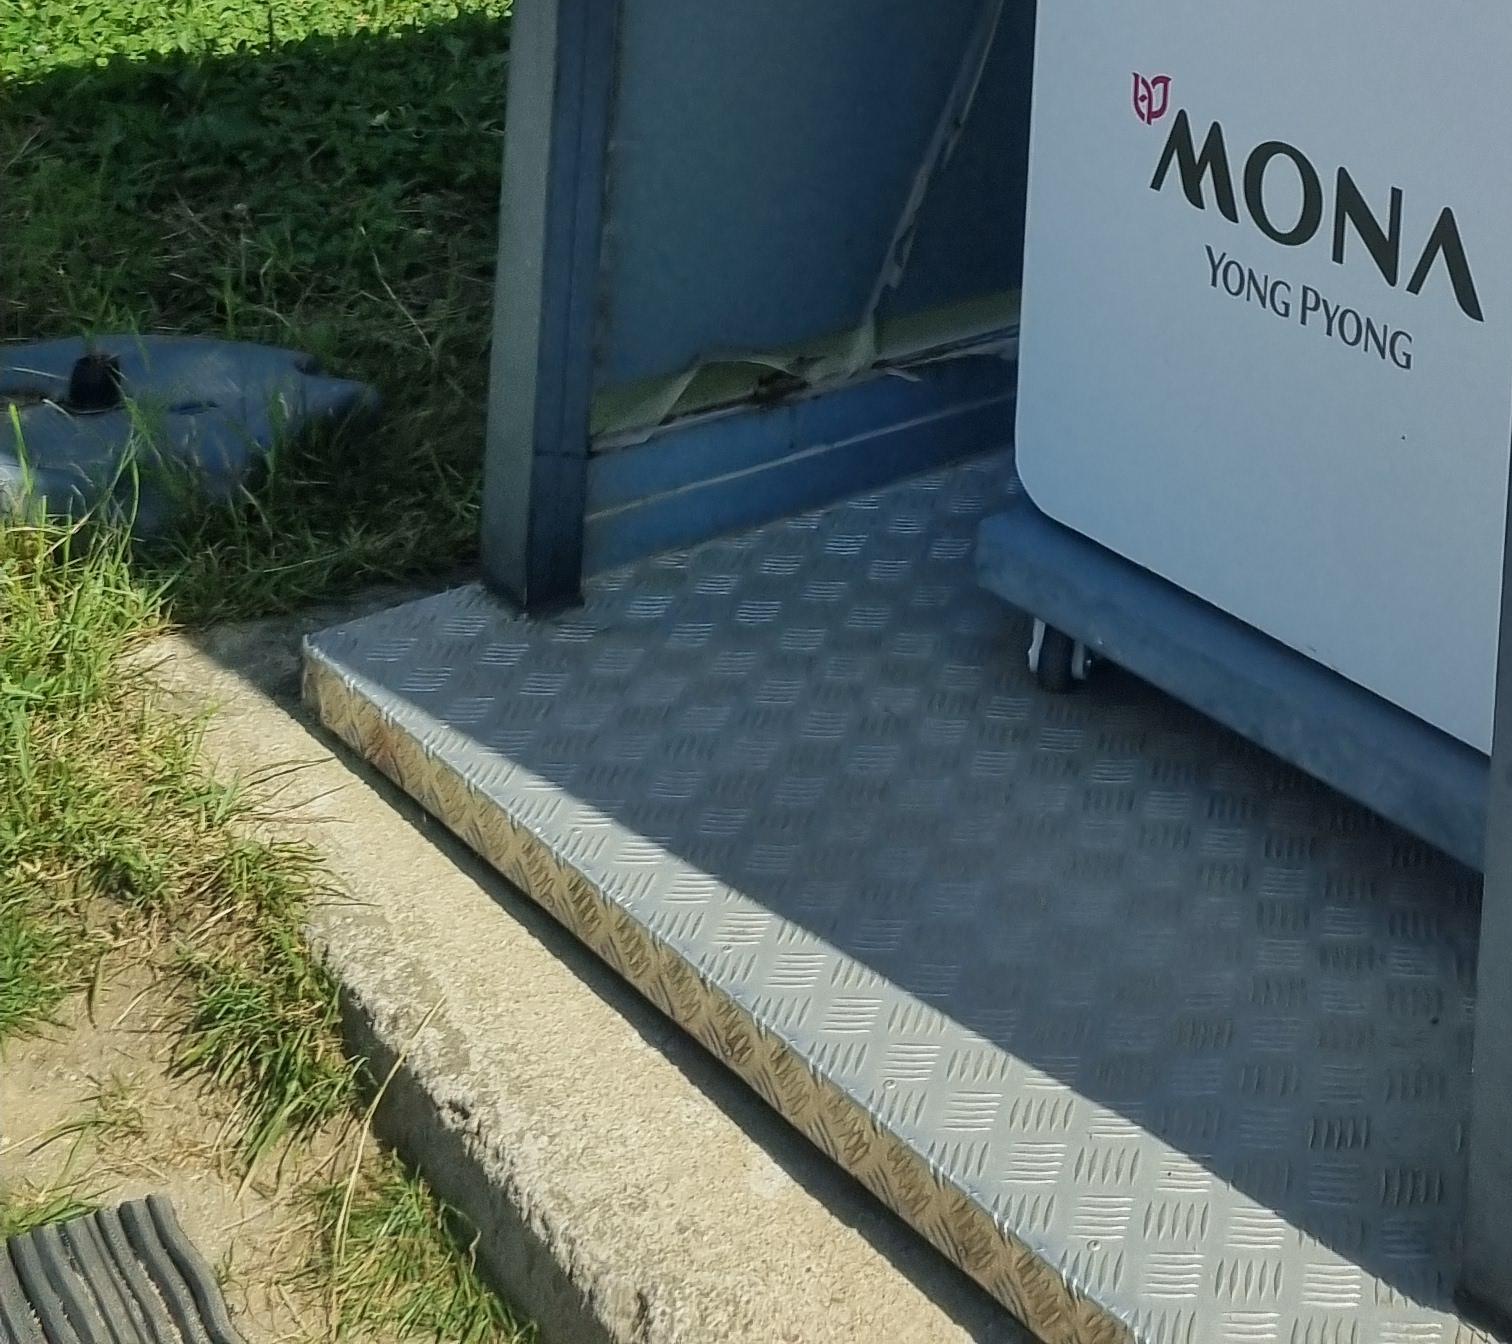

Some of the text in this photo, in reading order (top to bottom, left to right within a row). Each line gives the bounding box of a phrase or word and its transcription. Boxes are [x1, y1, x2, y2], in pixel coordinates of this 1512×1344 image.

[1149, 108, 1485, 323] MONA
[1204, 244, 1414, 371] YONG PYONG
